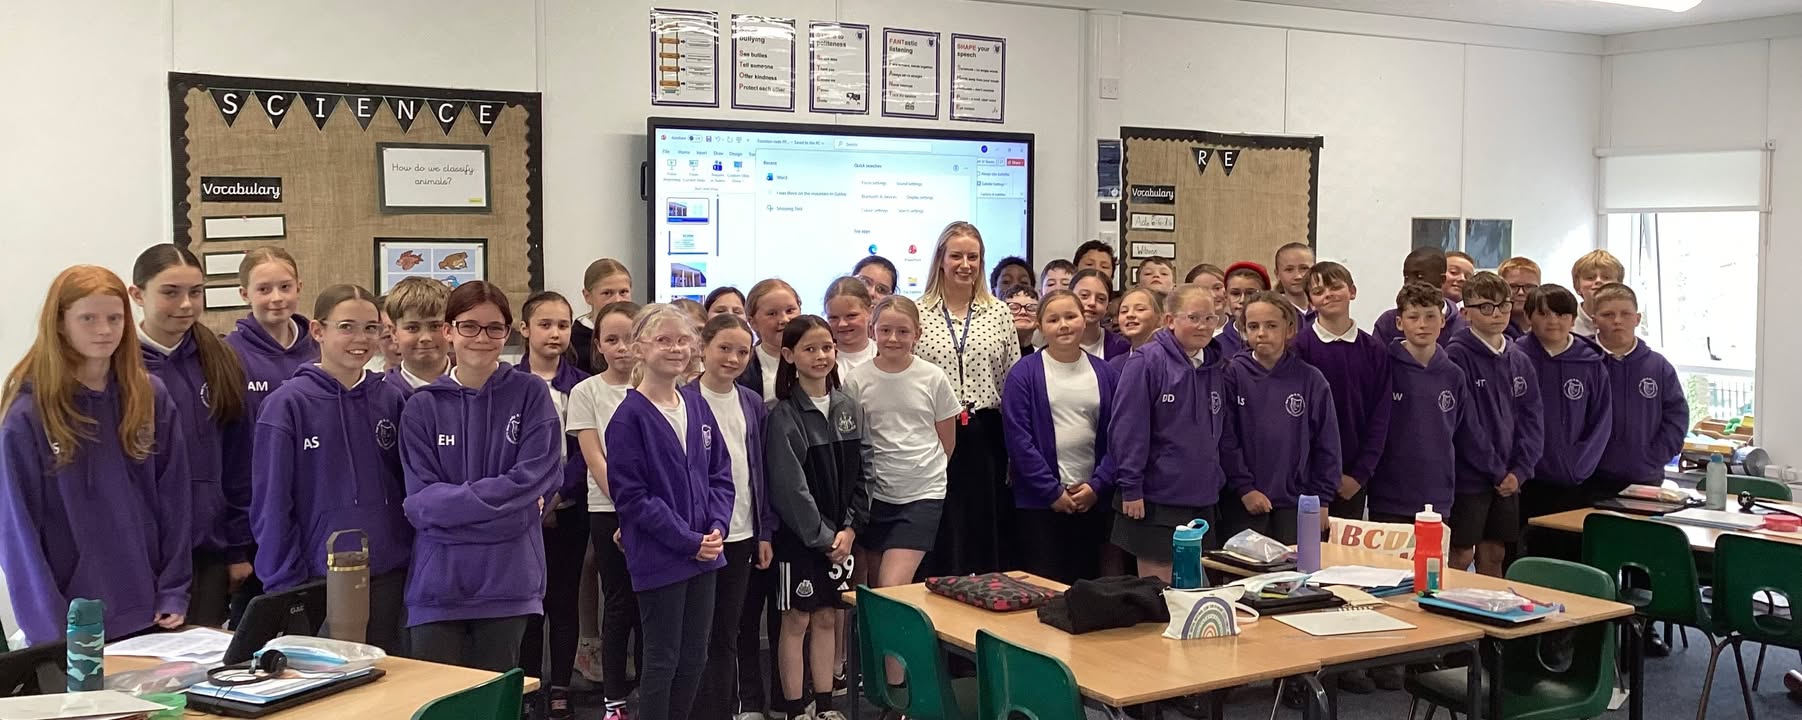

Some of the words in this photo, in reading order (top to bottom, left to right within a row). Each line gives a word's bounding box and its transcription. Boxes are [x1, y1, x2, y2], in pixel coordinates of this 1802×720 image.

[222, 93, 493, 124] SCIENCE
[392, 163, 411, 171] How
[414, 163, 425, 172] do
[443, 164, 474, 175] classify
[415, 177, 452, 185] animals?
[203, 183, 280, 199] Vocabulary
[1132, 188, 1174, 200] Vocabulary
[248, 381, 268, 391] AM
[303, 436, 320, 450] AS
[438, 434, 455, 446] EH
